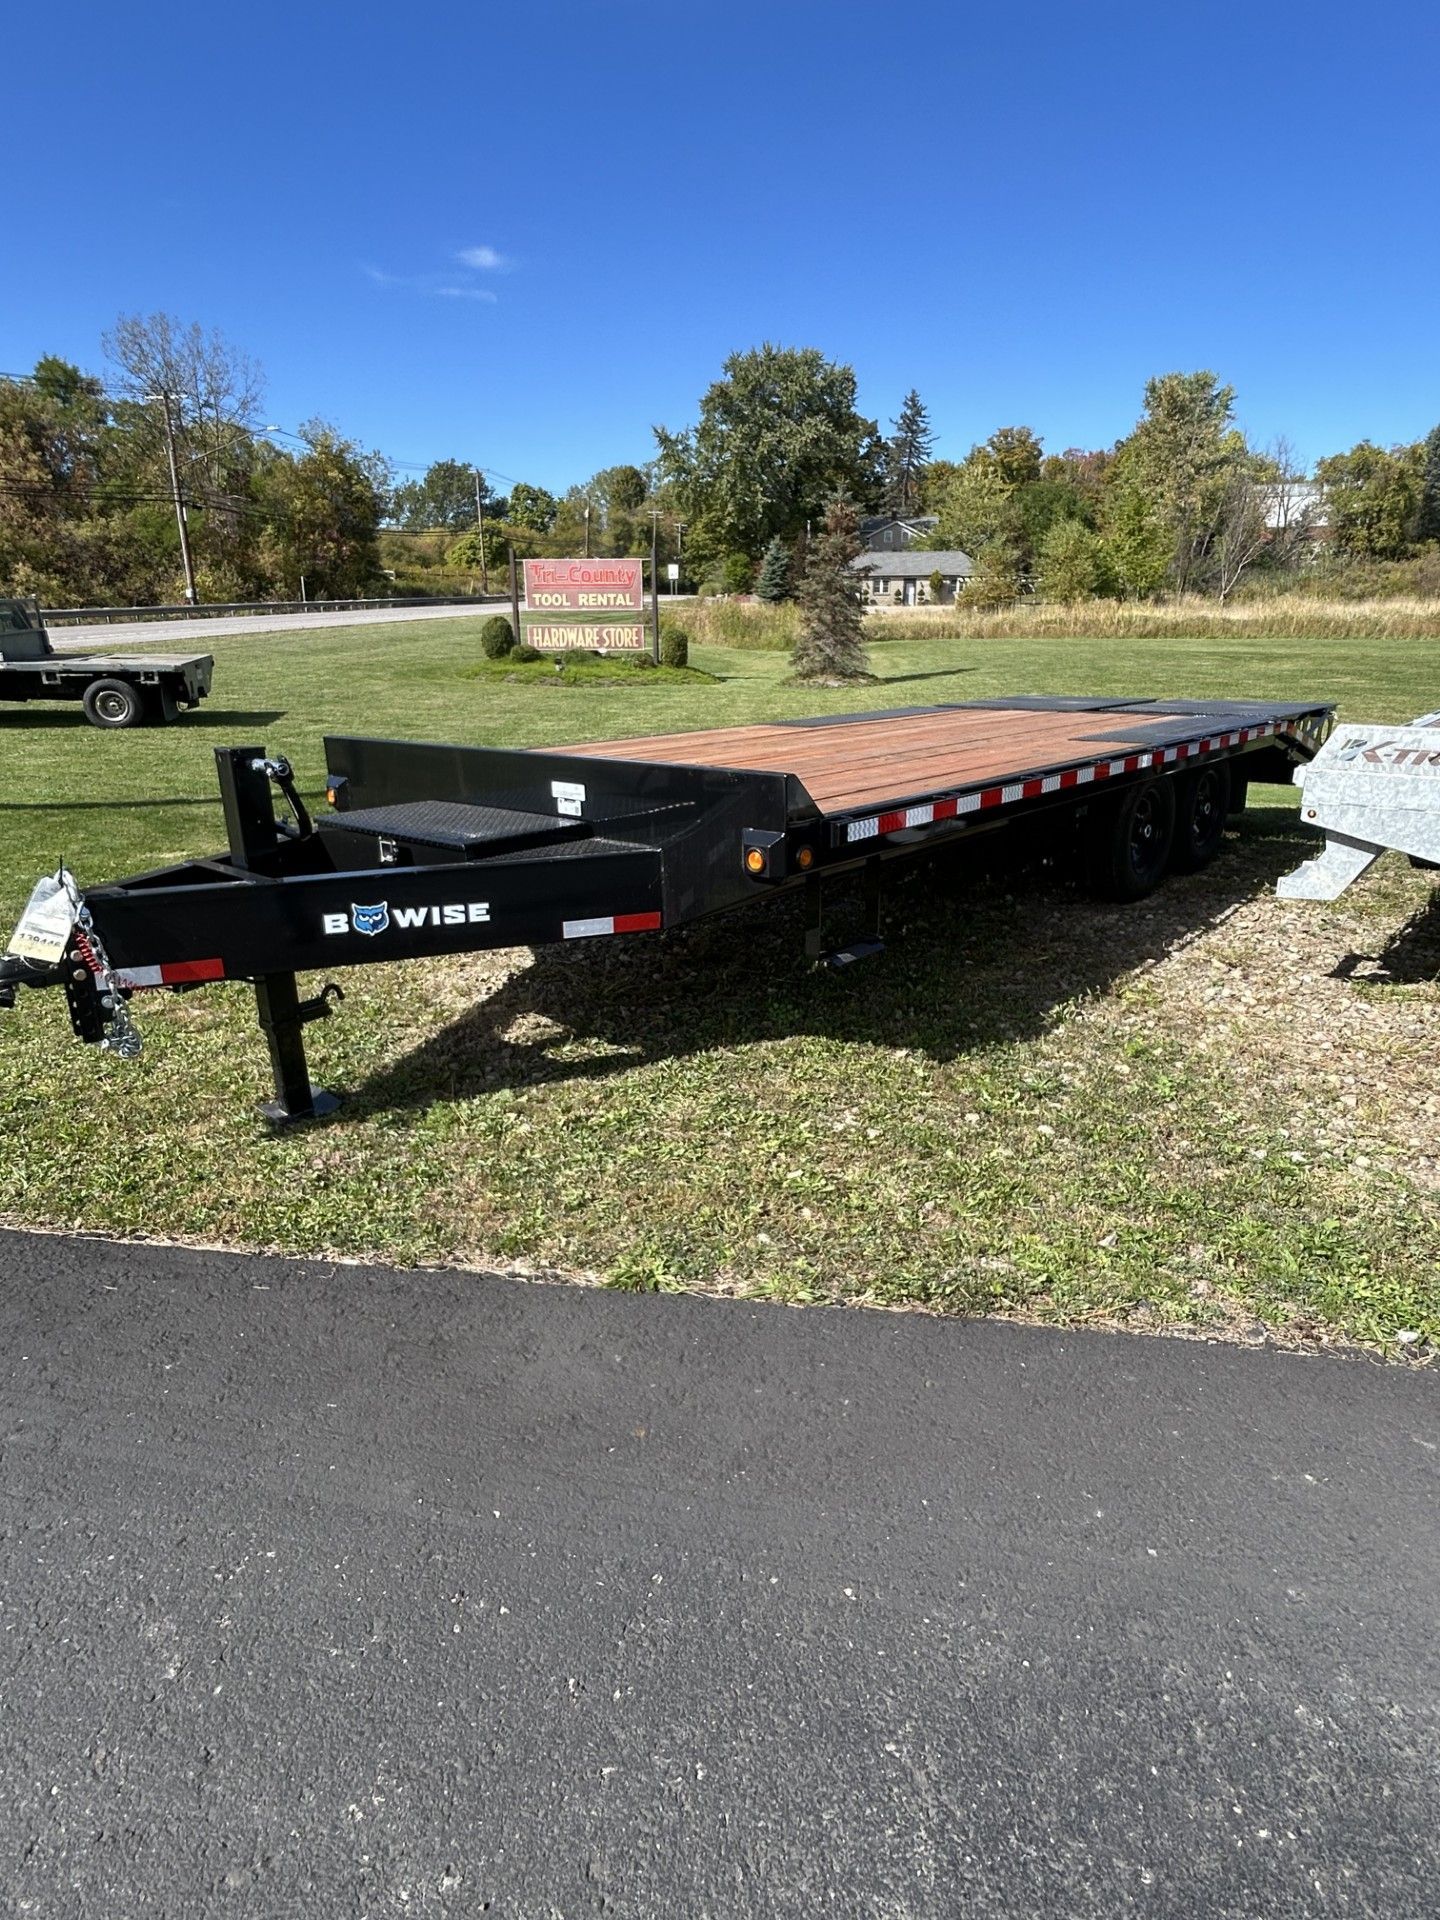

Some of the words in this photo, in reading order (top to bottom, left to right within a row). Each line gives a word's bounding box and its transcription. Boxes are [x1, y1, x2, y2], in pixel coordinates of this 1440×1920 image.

[529, 564, 637, 588] Tri-County
[532, 593, 571, 606] TOOL
[578, 593, 634, 606] RENTAL
[533, 627, 600, 647] HARDWARE
[603, 627, 639, 648] STORE
